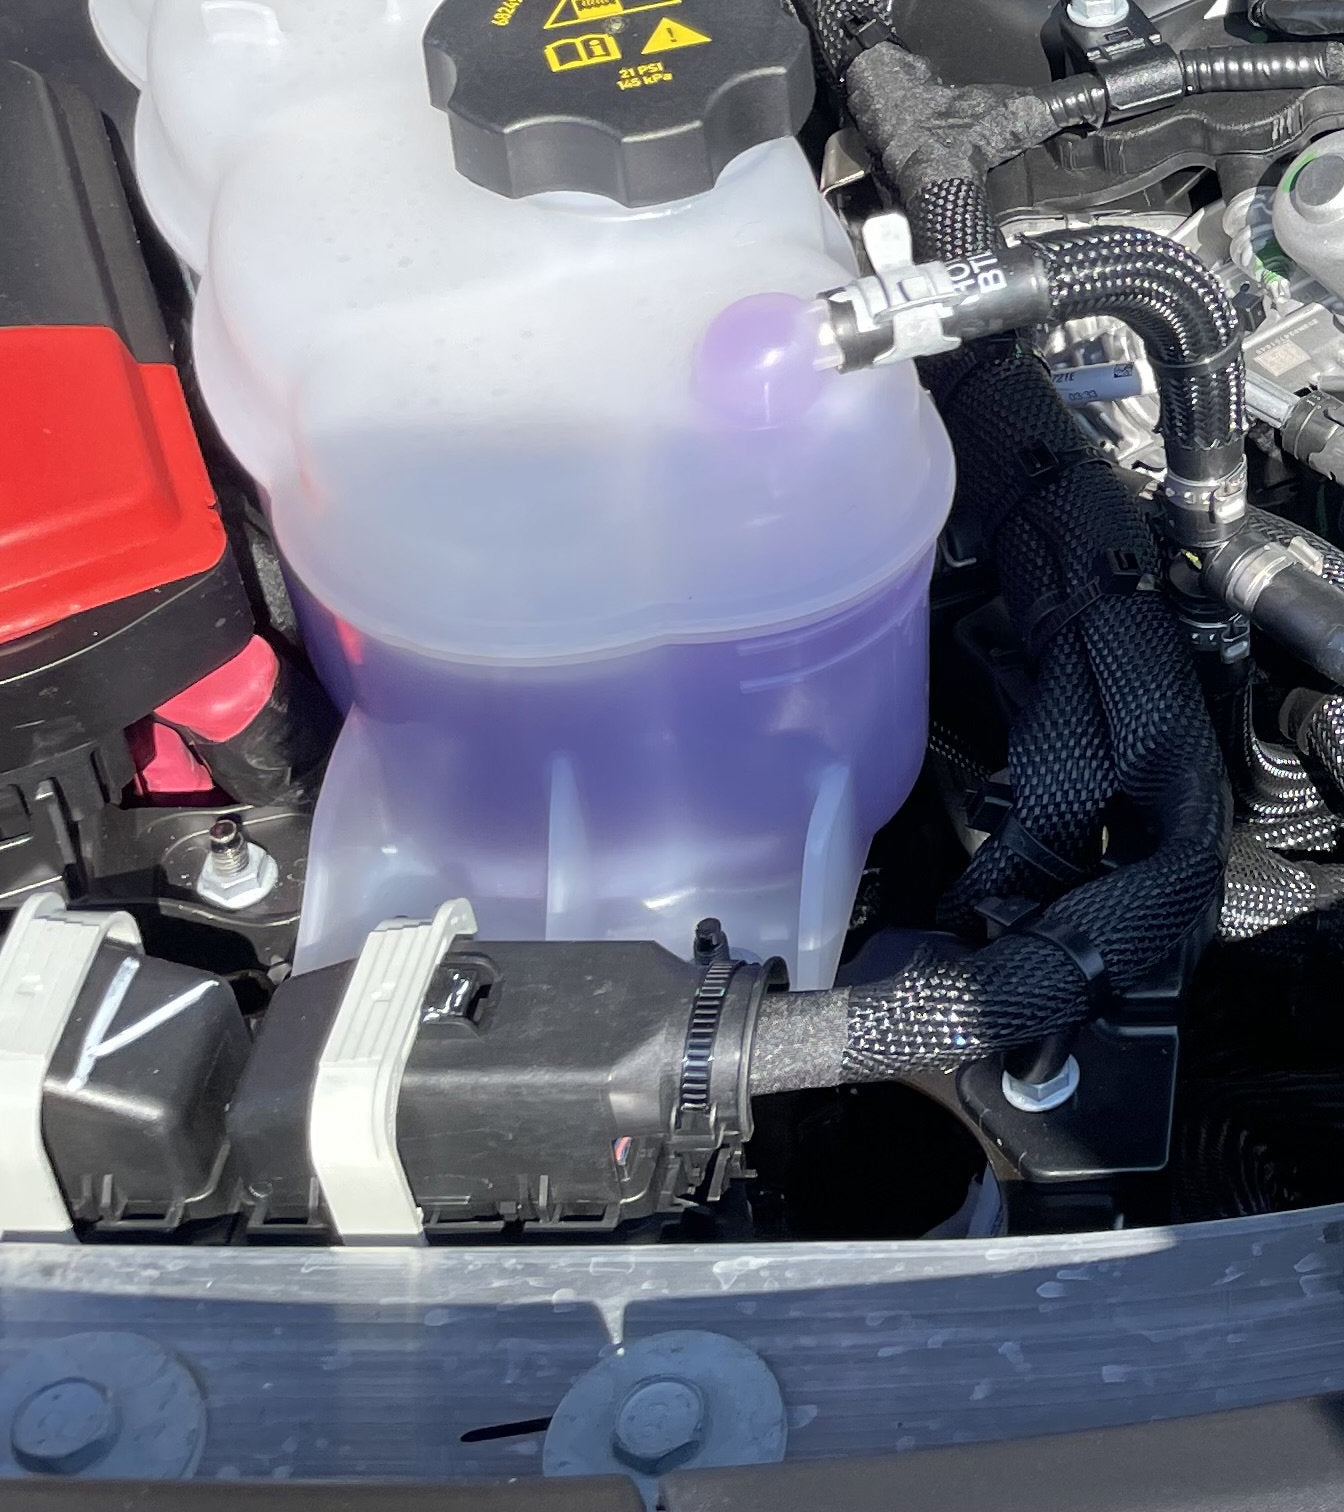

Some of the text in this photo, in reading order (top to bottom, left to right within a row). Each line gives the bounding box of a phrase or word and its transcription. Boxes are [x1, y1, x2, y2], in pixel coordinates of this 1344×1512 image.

[618, 61, 664, 79] 21 PSI
[616, 71, 673, 91] 145 kPa
